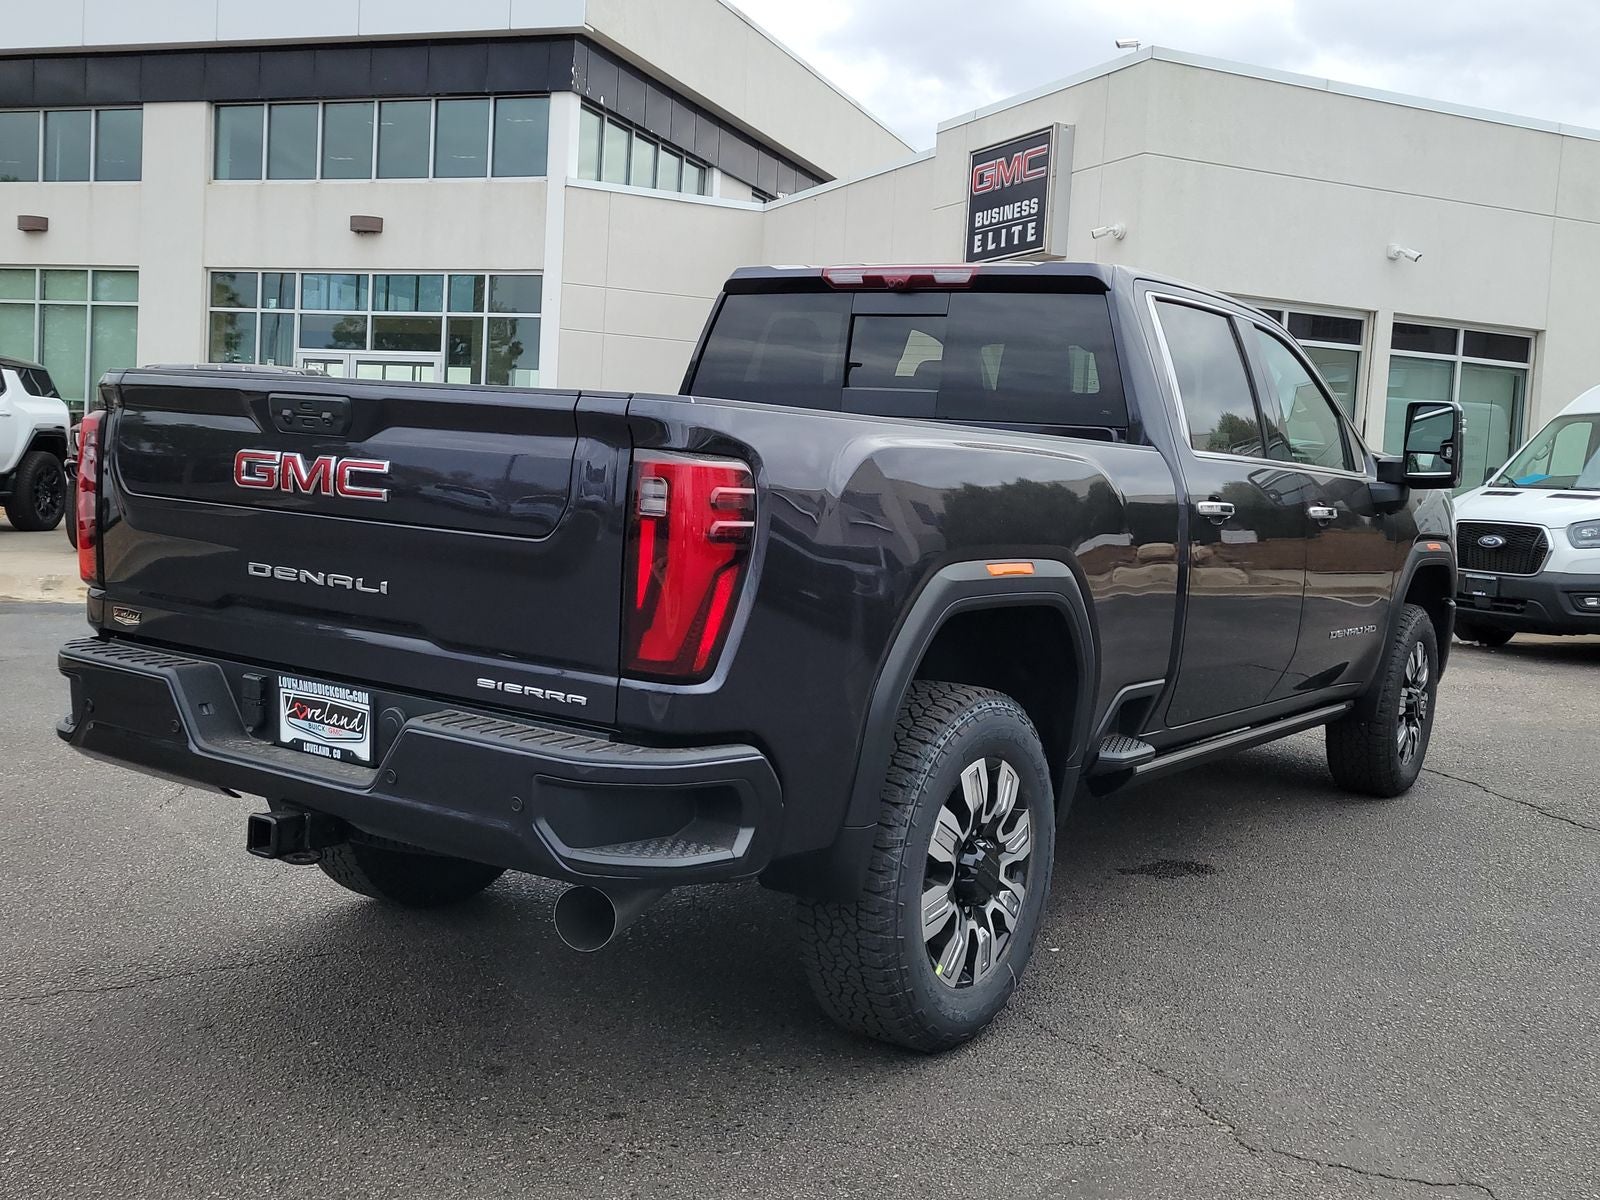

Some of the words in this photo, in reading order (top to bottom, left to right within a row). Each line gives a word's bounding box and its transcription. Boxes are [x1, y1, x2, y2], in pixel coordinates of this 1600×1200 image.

[972, 144, 1049, 195] GMC
[975, 197, 1039, 228] BUSINESS
[973, 221, 1037, 253] ELITE
[233, 448, 391, 502] GMC
[247, 561, 388, 595] DENALI
[476, 678, 588, 706] SIERRA
[308, 722, 325, 732] BUICK
[328, 727, 343, 737] GMC
[332, 749, 341, 759] CO
